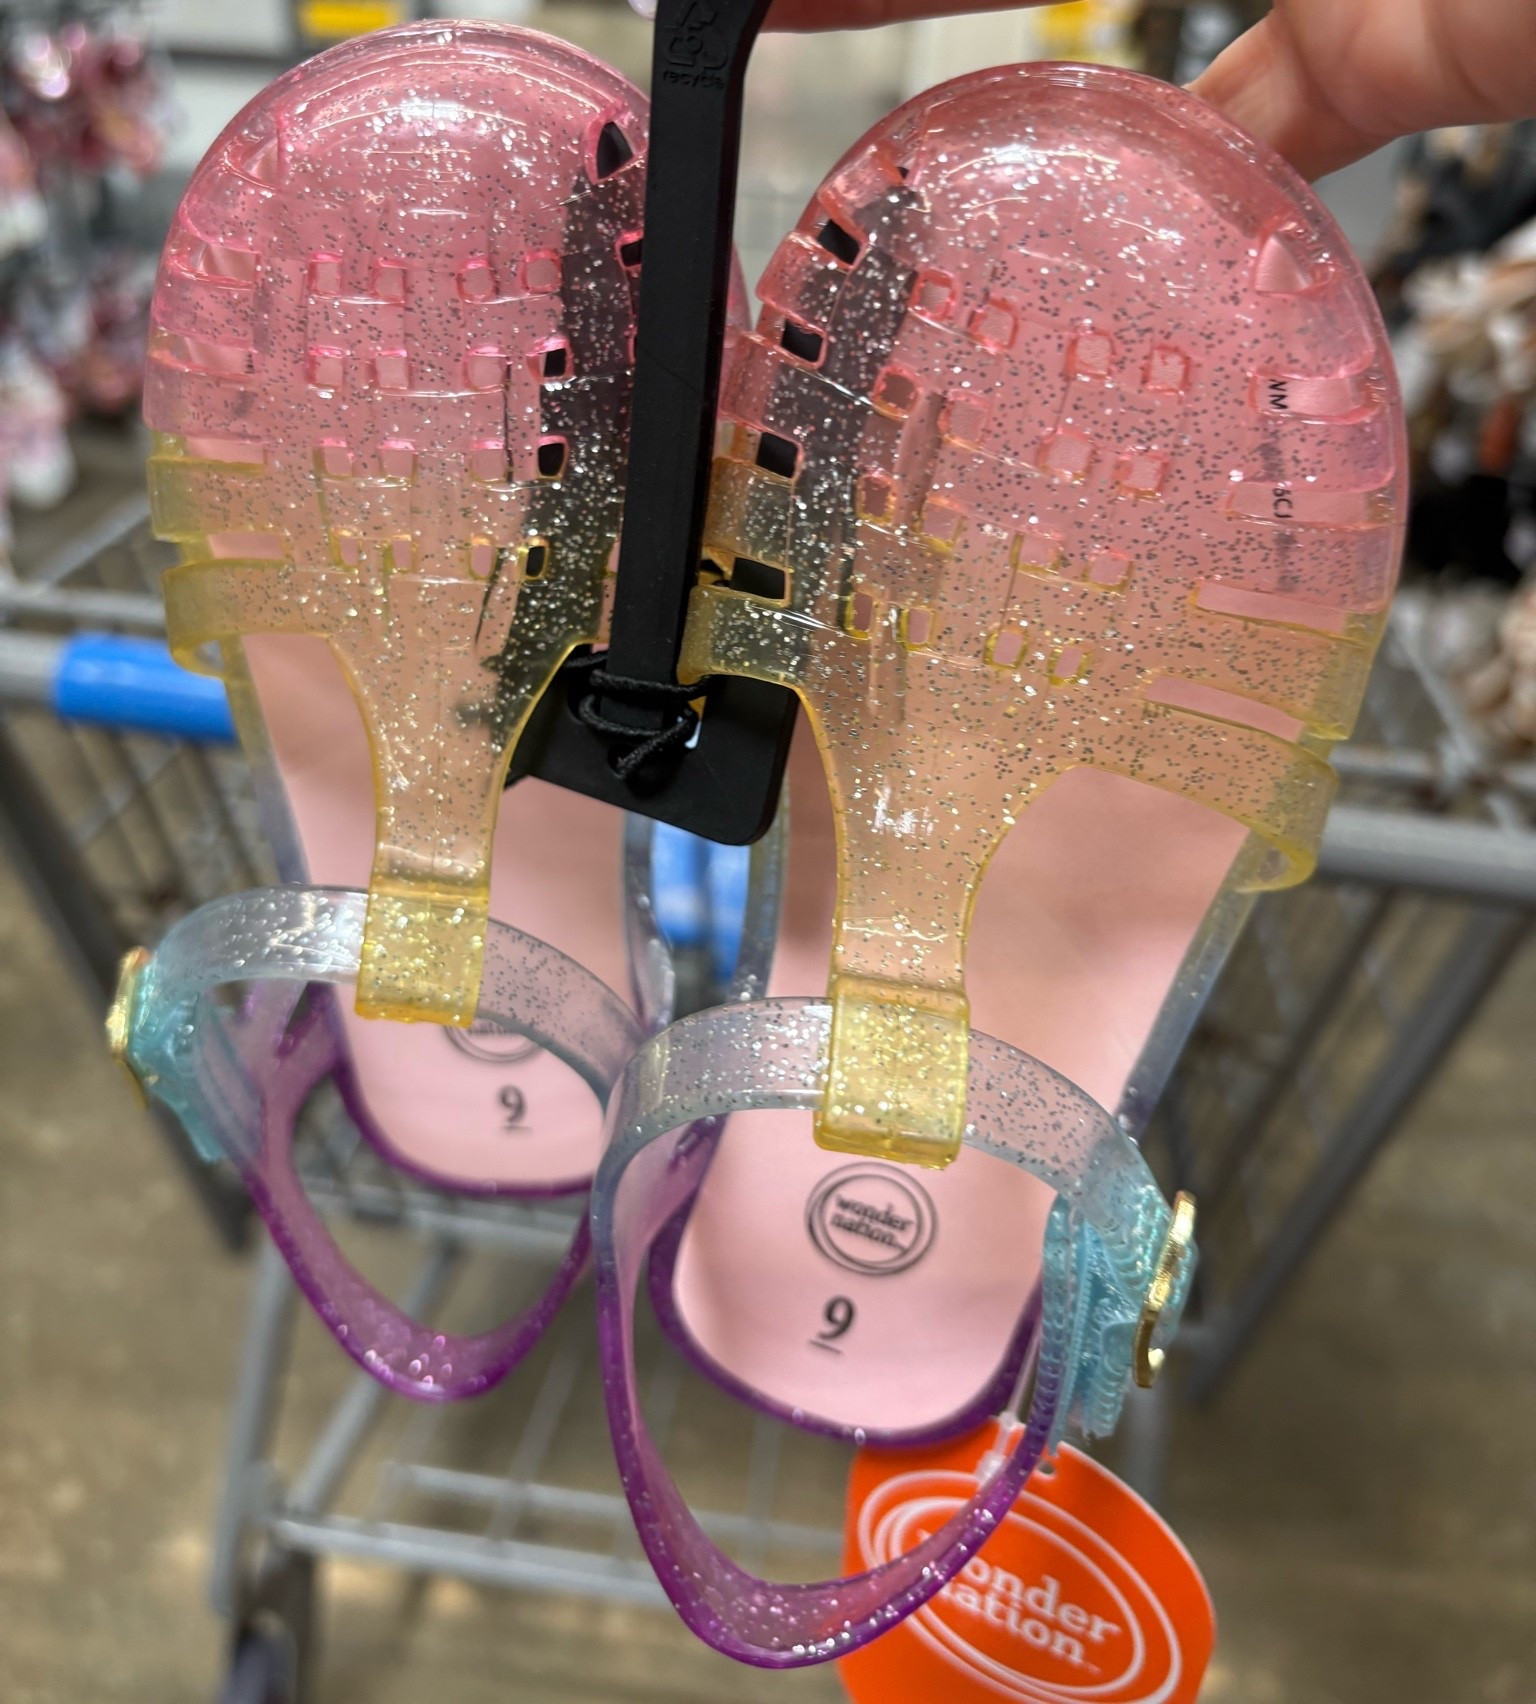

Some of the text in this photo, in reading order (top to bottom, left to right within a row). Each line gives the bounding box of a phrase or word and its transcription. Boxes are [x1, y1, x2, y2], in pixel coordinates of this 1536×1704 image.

[497, 1084, 527, 1124] 9
[836, 1195, 914, 1231] wonder
[817, 1294, 857, 1342] 9
[919, 1529, 1122, 1643] onder
[938, 1580, 1085, 1668] ation
